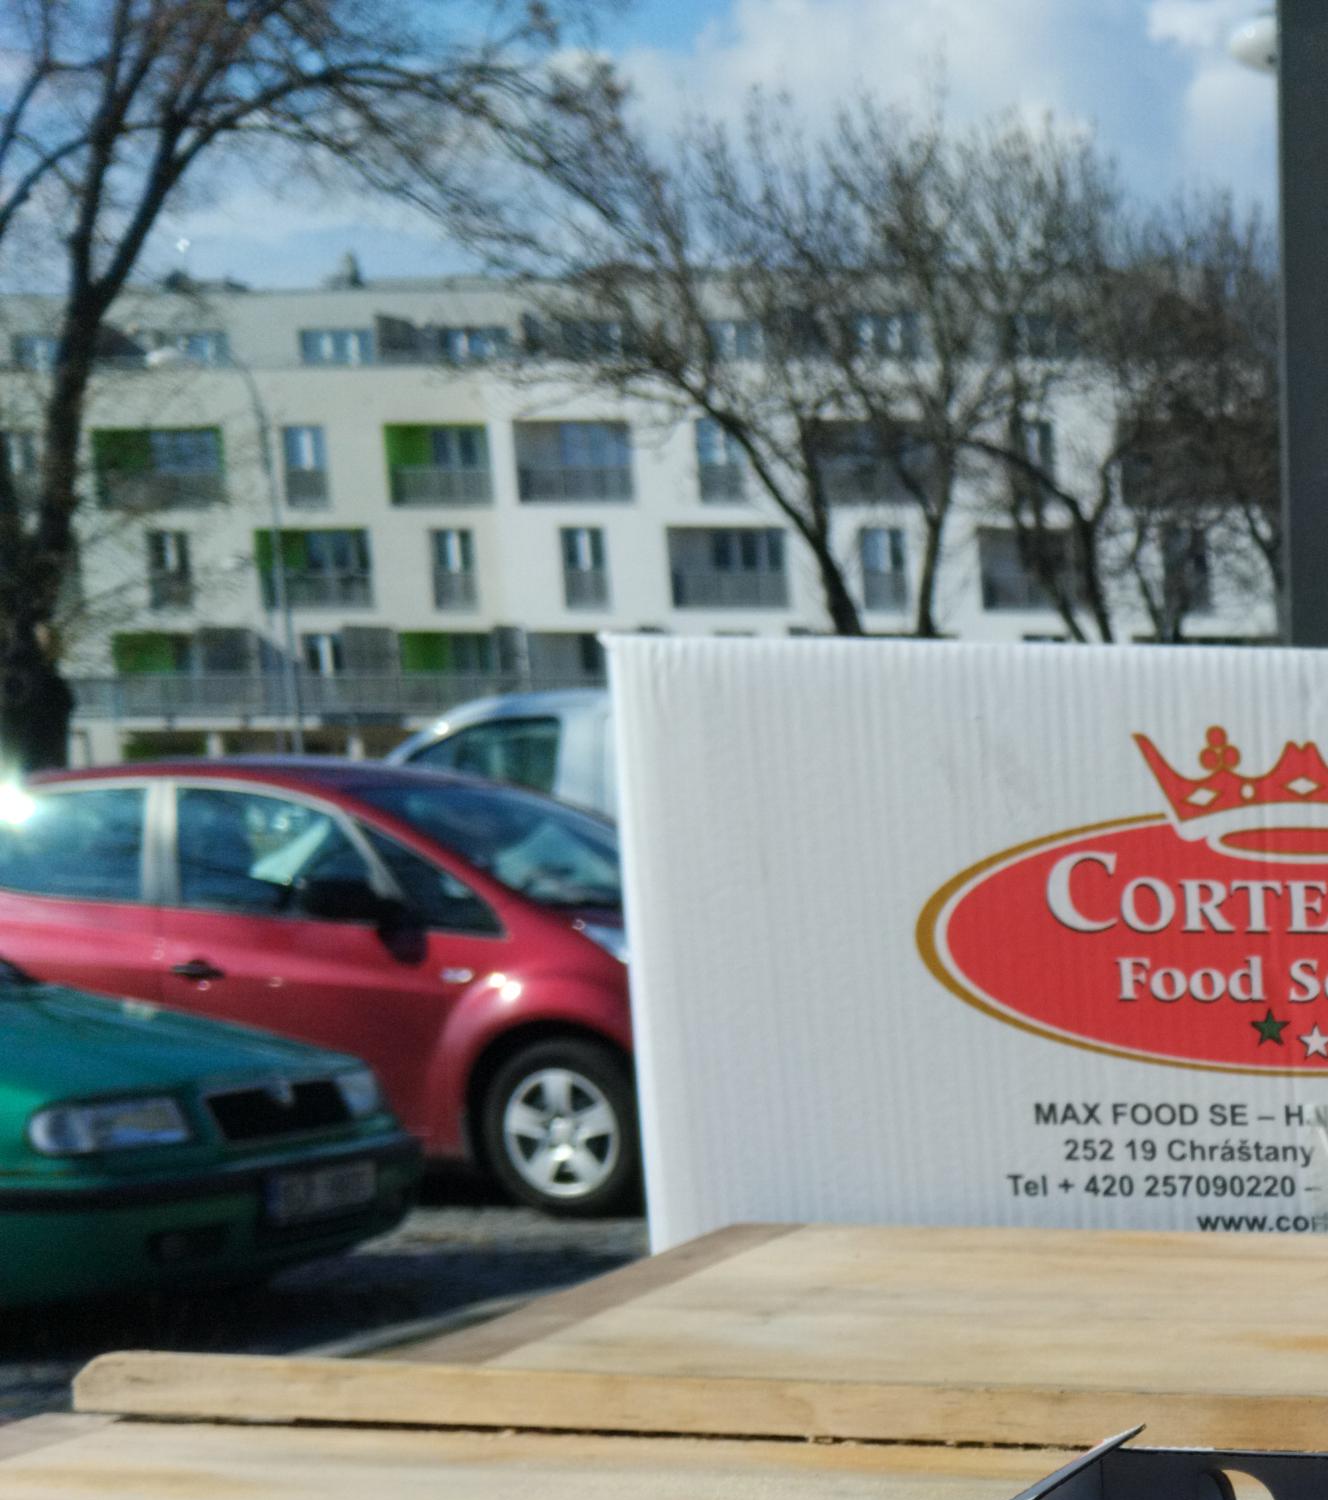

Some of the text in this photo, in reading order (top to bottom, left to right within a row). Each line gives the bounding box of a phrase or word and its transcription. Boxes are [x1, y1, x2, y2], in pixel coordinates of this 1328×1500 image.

[1116, 957, 1264, 1004] Food
[1034, 1103, 1102, 1125] MAX
[1112, 1103, 1199, 1126] FOOD
[1209, 1104, 1248, 1126] SE
[1064, 1139, 1114, 1161] 252
[1125, 1139, 1157, 1161] 19
[1167, 1138, 1314, 1168] Chráštany
[1007, 1174, 1048, 1197] Tel
[1084, 1175, 1134, 1197] 420
[1144, 1175, 1296, 1198] 257090220
